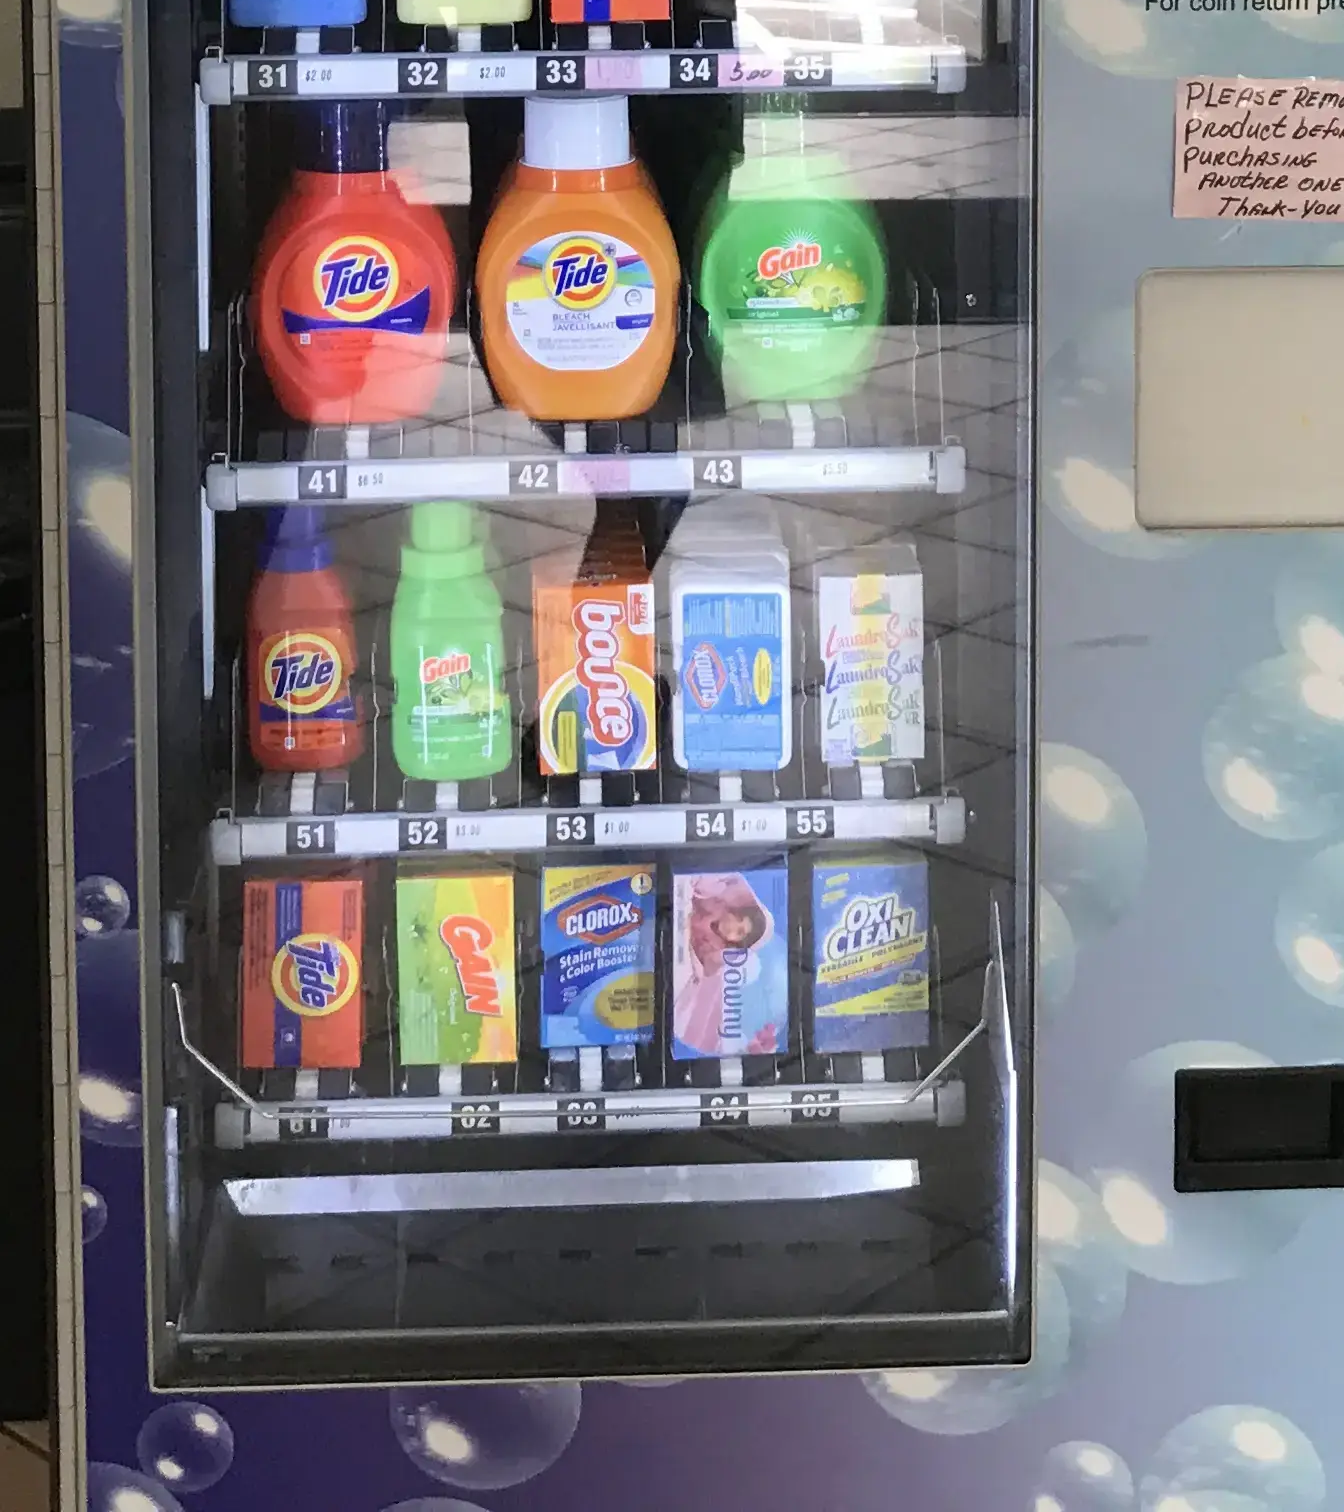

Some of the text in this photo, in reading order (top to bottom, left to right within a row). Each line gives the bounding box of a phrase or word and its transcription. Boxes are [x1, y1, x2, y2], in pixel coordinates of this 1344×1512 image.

[258, 57, 825, 88] 31 32 $2.00 33 34 35
[1186, 81, 1287, 110] PLEASE
[553, 256, 608, 296] Tide
[758, 243, 821, 279] Gain
[321, 255, 391, 309] Tide
[553, 313, 590, 321] BLEACH
[553, 321, 616, 331] JAVELLISANT
[308, 459, 734, 492] 41 42 43
[271, 652, 334, 699] Tide
[421, 653, 470, 684] Gain
[576, 601, 632, 745] bounce
[296, 810, 827, 848] 51 52 53 54 55
[846, 897, 894, 931] OXI
[828, 911, 912, 960] CLEAN
[286, 941, 339, 1010] Tide
[559, 949, 591, 969] Stain
[567, 962, 595, 979] Color
[719, 948, 748, 1039] Downy
